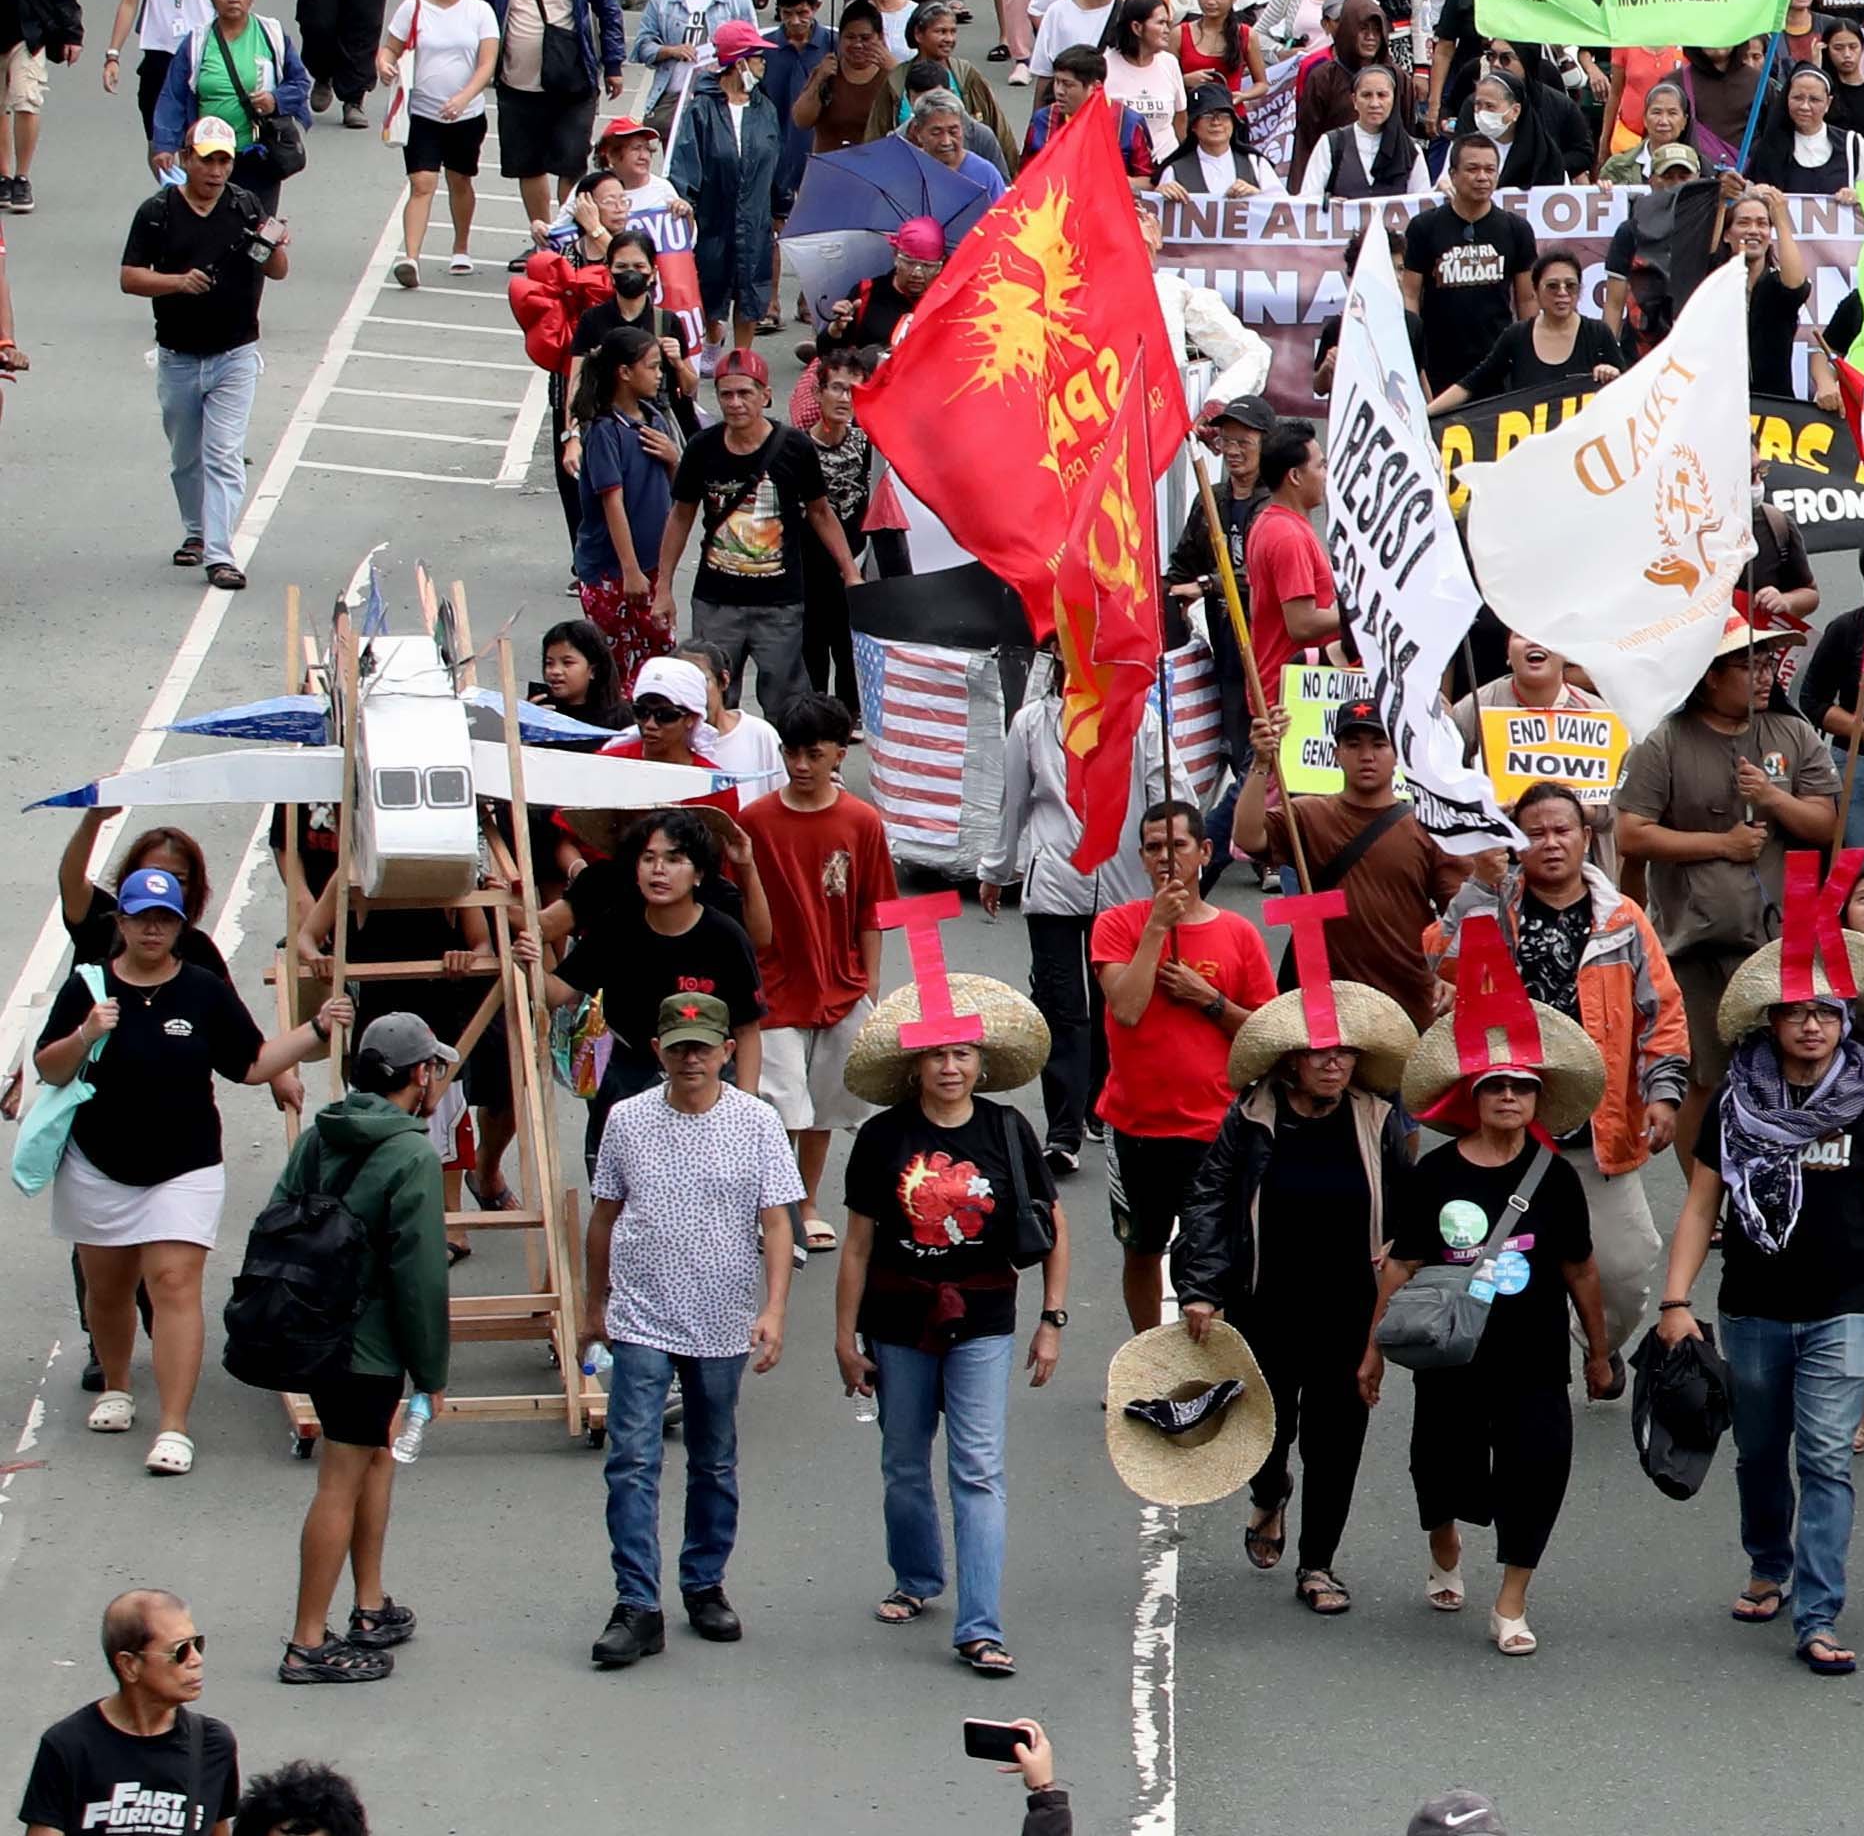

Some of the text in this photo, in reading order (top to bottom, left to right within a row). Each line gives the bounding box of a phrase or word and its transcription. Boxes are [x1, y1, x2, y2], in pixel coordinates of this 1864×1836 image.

[1441, 256, 1506, 283] Masa!
[1301, 677, 1323, 701] NO
[1506, 716, 1609, 748] END VAWC
[1508, 750, 1608, 780] NOW!
[1454, 915, 1542, 1074] A
[113, 1782, 189, 1810] FART
